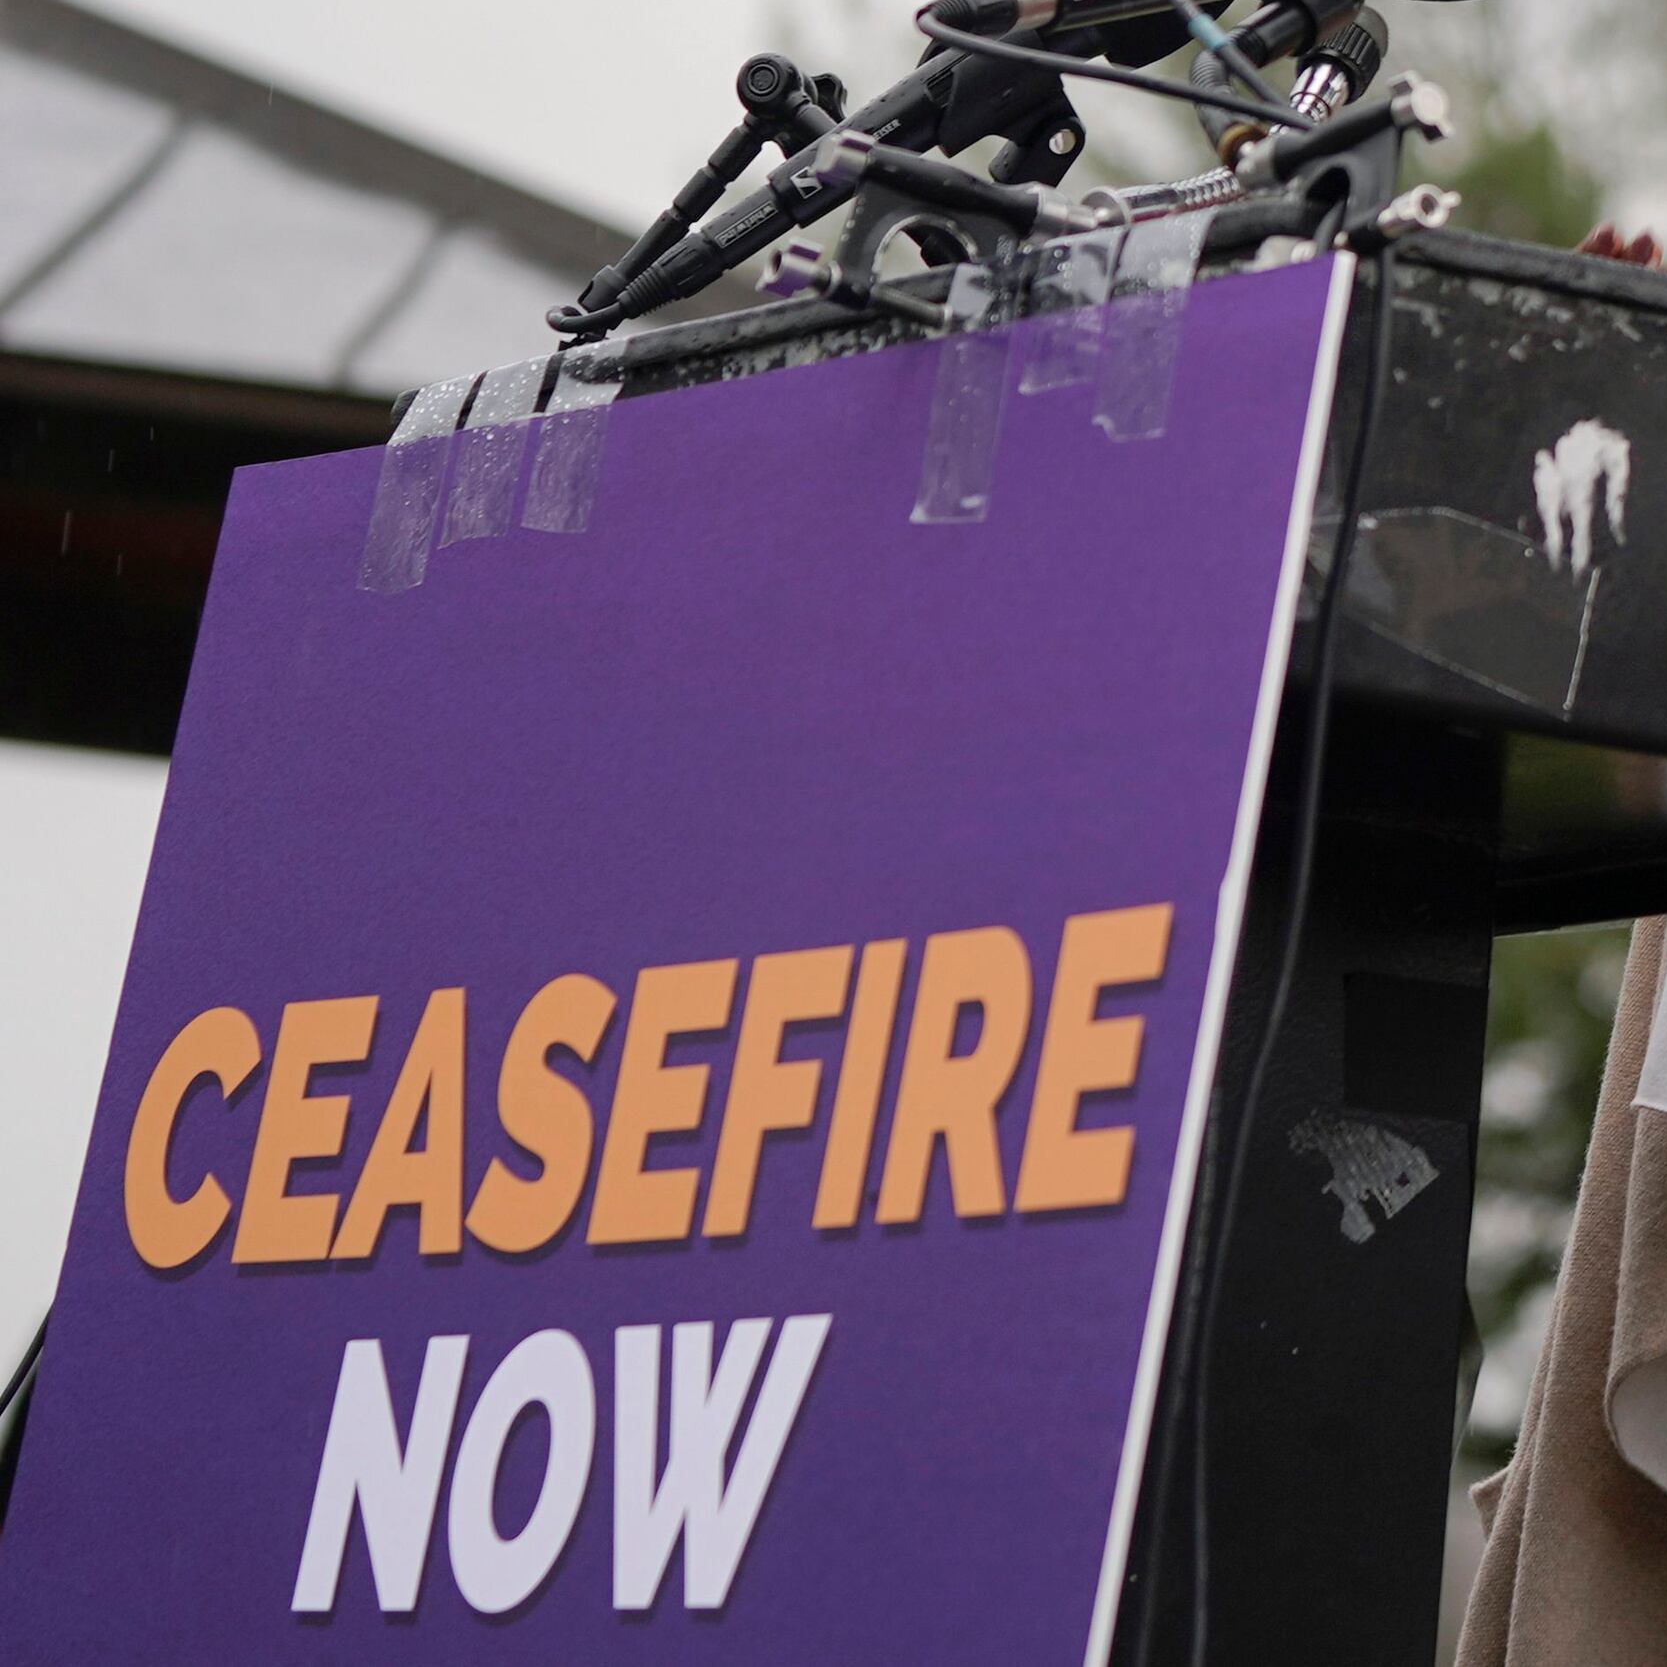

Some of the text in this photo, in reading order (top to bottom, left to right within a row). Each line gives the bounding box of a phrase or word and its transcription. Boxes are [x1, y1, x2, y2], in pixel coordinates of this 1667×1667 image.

[872, 118, 902, 142] EISER
[123, 902, 1173, 1269] CEASEFIRE
[290, 1312, 833, 1614] NOW
